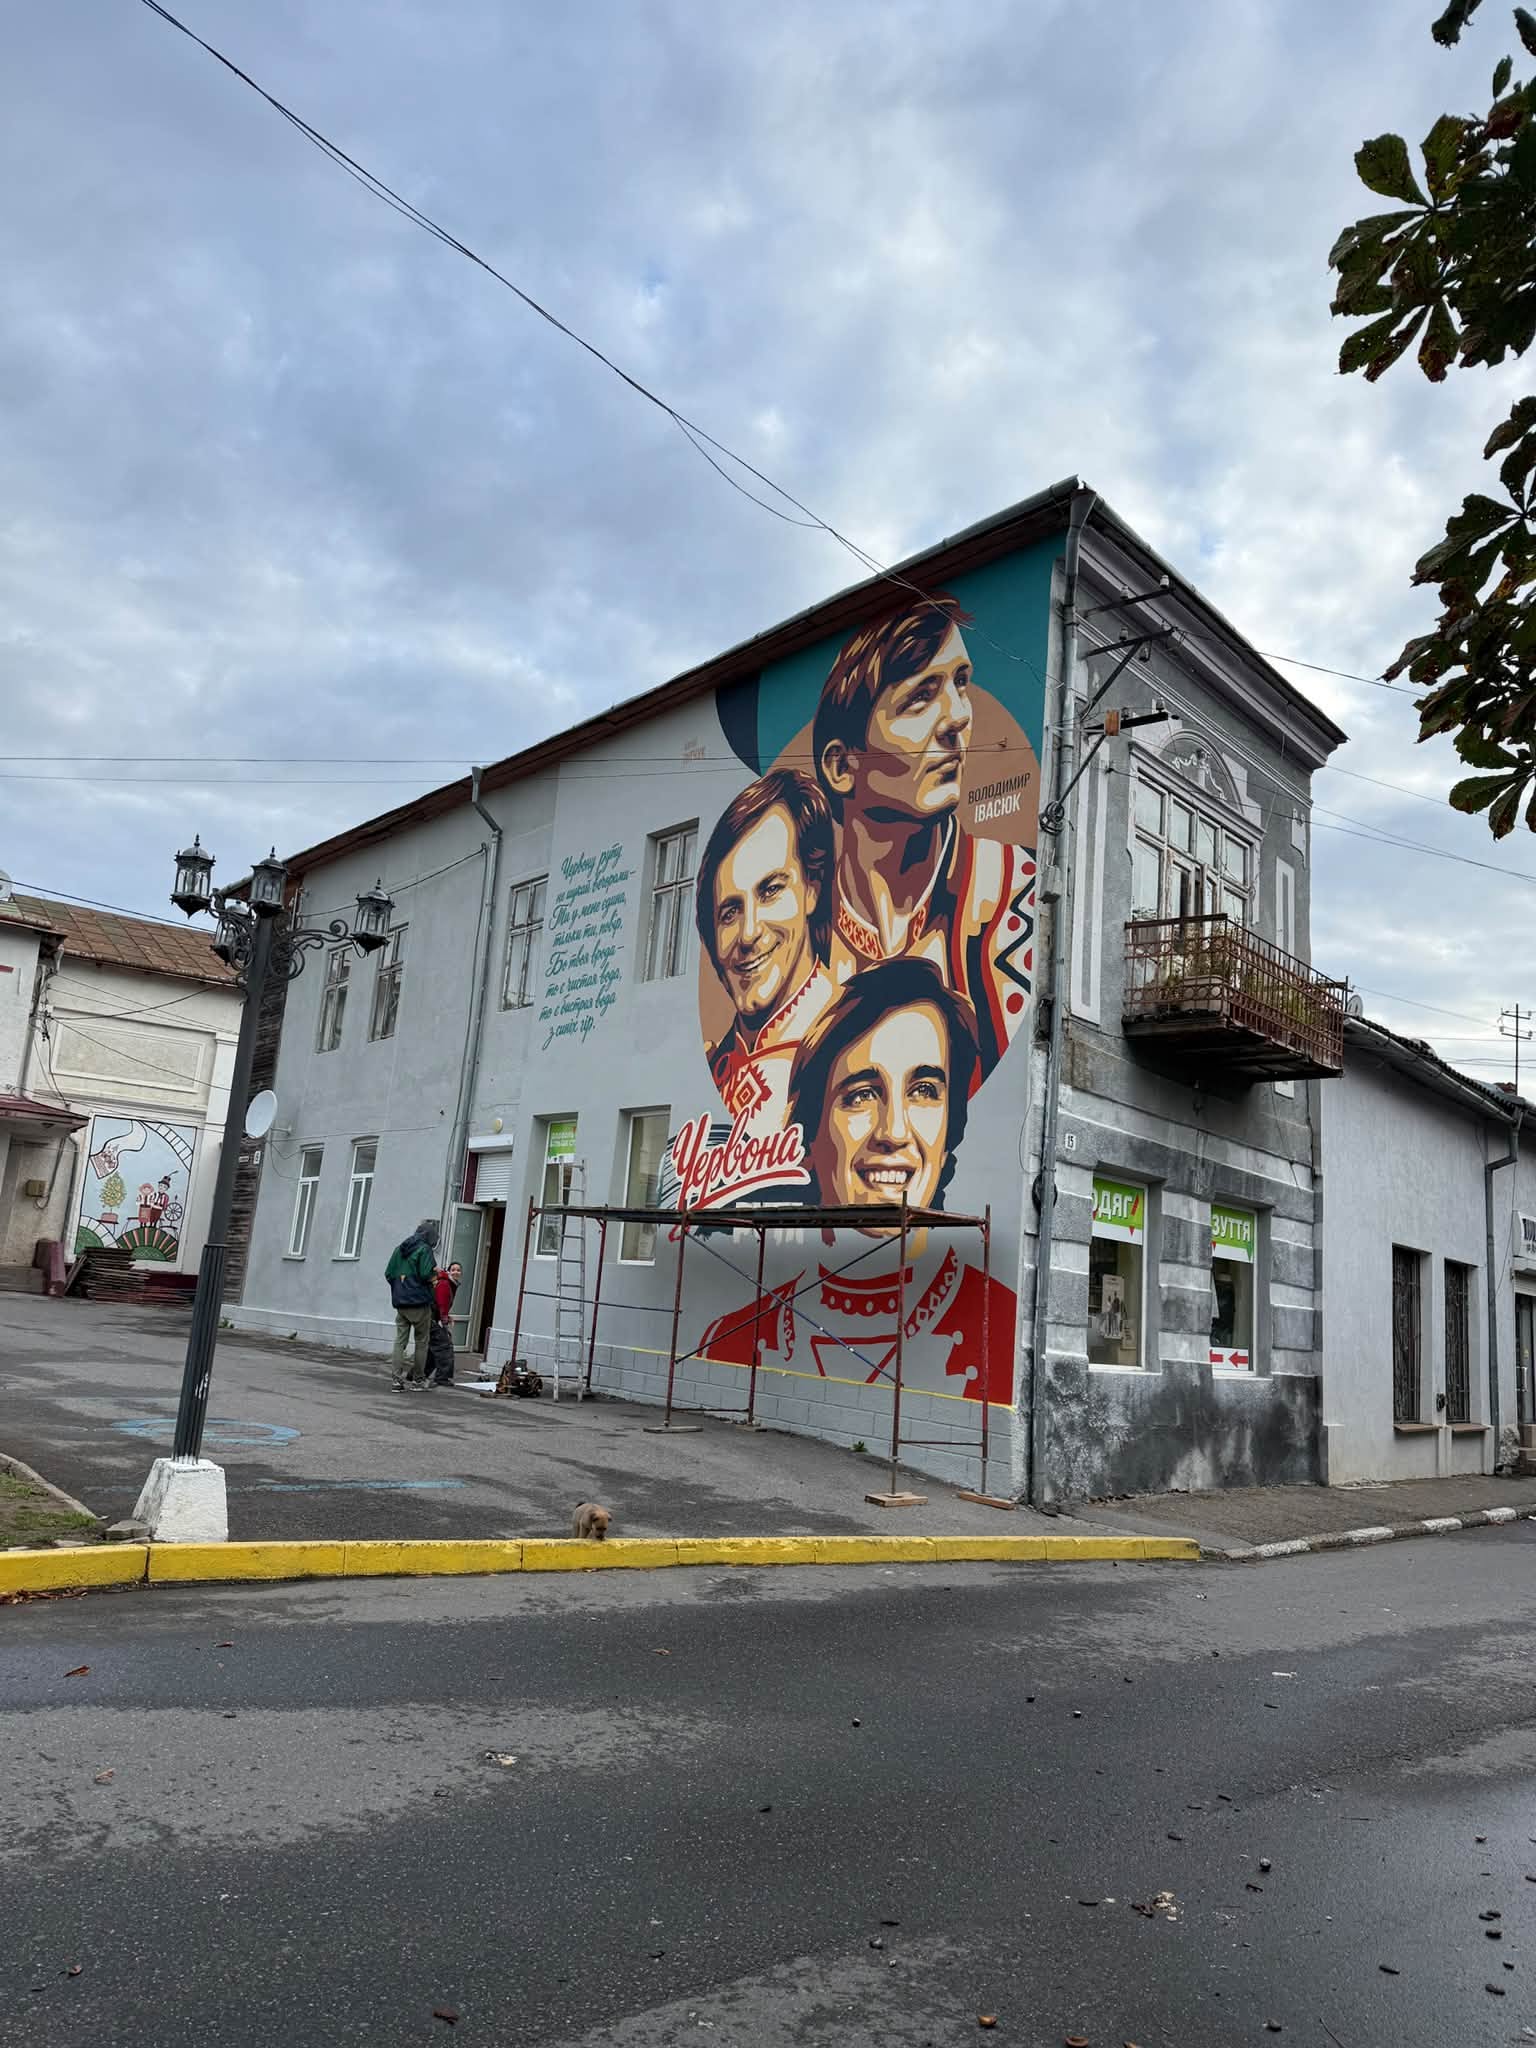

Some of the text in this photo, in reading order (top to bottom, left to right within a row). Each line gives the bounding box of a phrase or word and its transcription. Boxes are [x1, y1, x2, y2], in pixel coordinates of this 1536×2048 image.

[968, 773, 1030, 804] ВОЛОДИМИР
[974, 792, 1022, 824] ІВАСЮК
[671, 1106, 803, 1213] Червона
